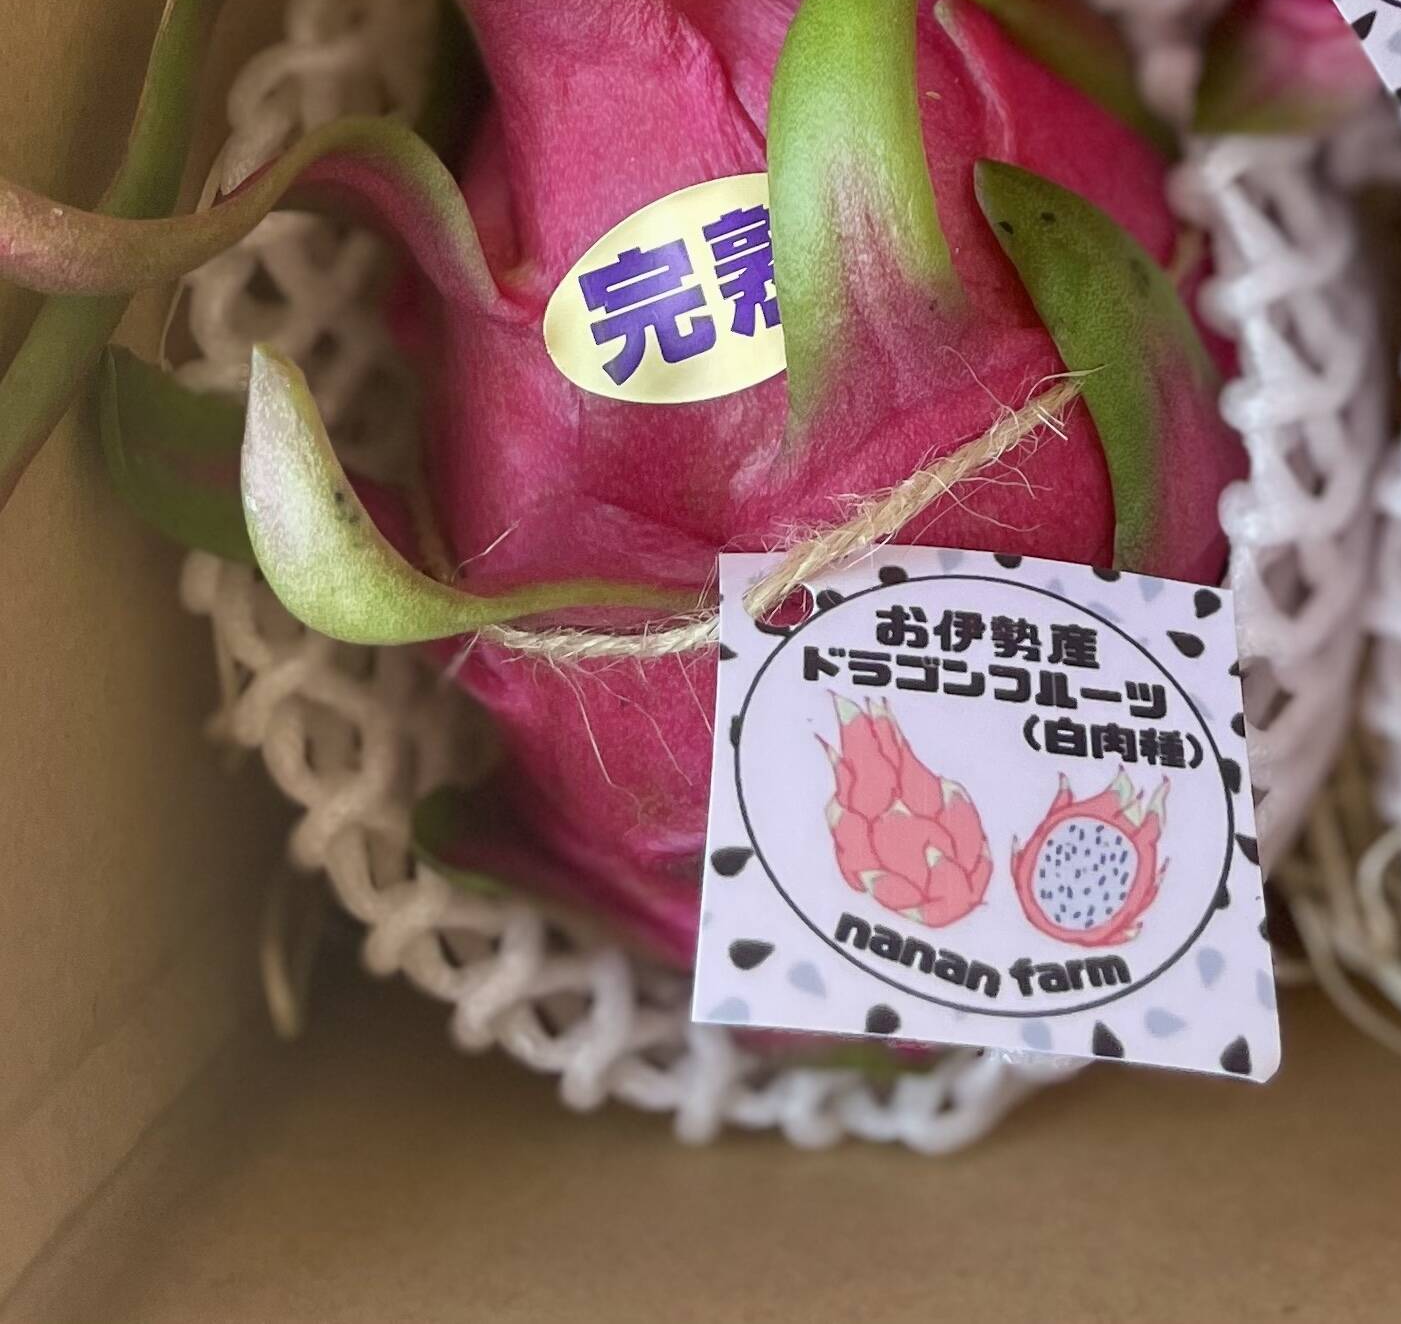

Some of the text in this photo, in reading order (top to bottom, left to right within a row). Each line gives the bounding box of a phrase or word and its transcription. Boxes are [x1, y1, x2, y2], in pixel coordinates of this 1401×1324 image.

[876, 605, 1101, 670] お伊勢産
[803, 646, 1168, 719] ドラゴンフルーツ
[834, 912, 1132, 998] nanan farm
